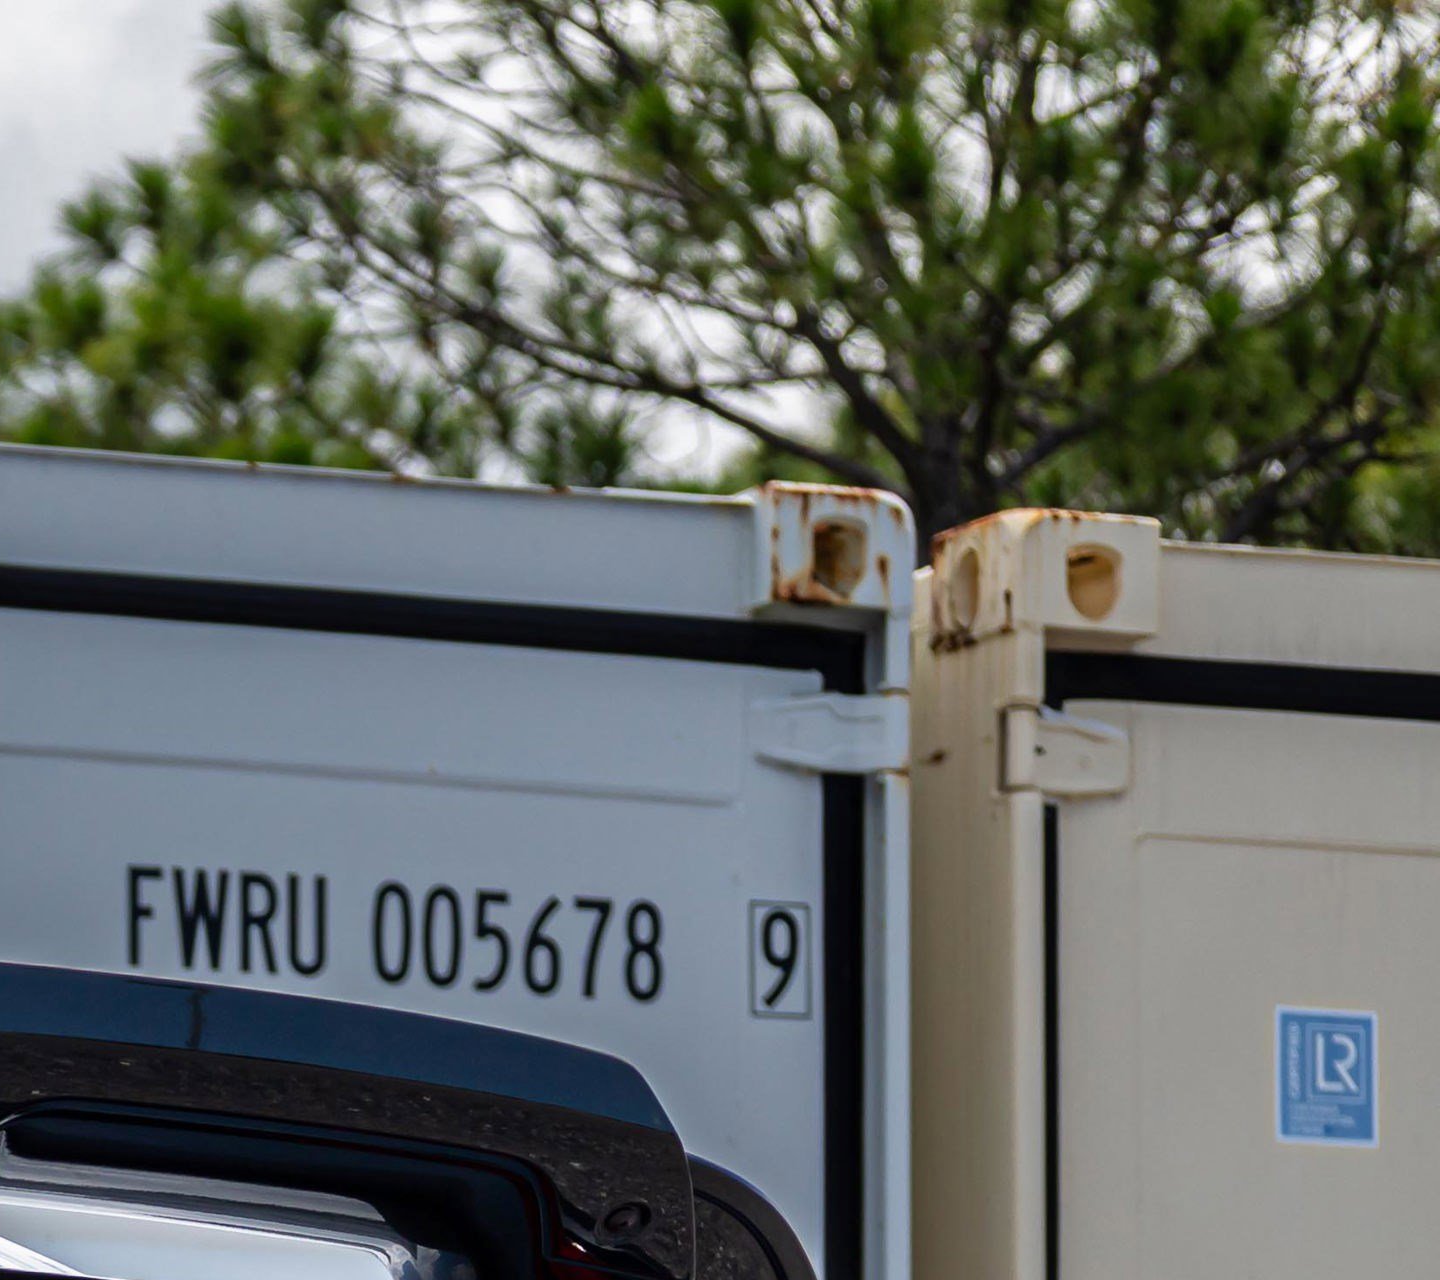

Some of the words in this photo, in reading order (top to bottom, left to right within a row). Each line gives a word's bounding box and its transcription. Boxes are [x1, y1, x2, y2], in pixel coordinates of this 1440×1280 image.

[126, 865, 328, 977] FWRU
[372, 881, 664, 1004] 005678
[761, 909, 801, 1007] 9
[1315, 1032, 1360, 1093] LR
